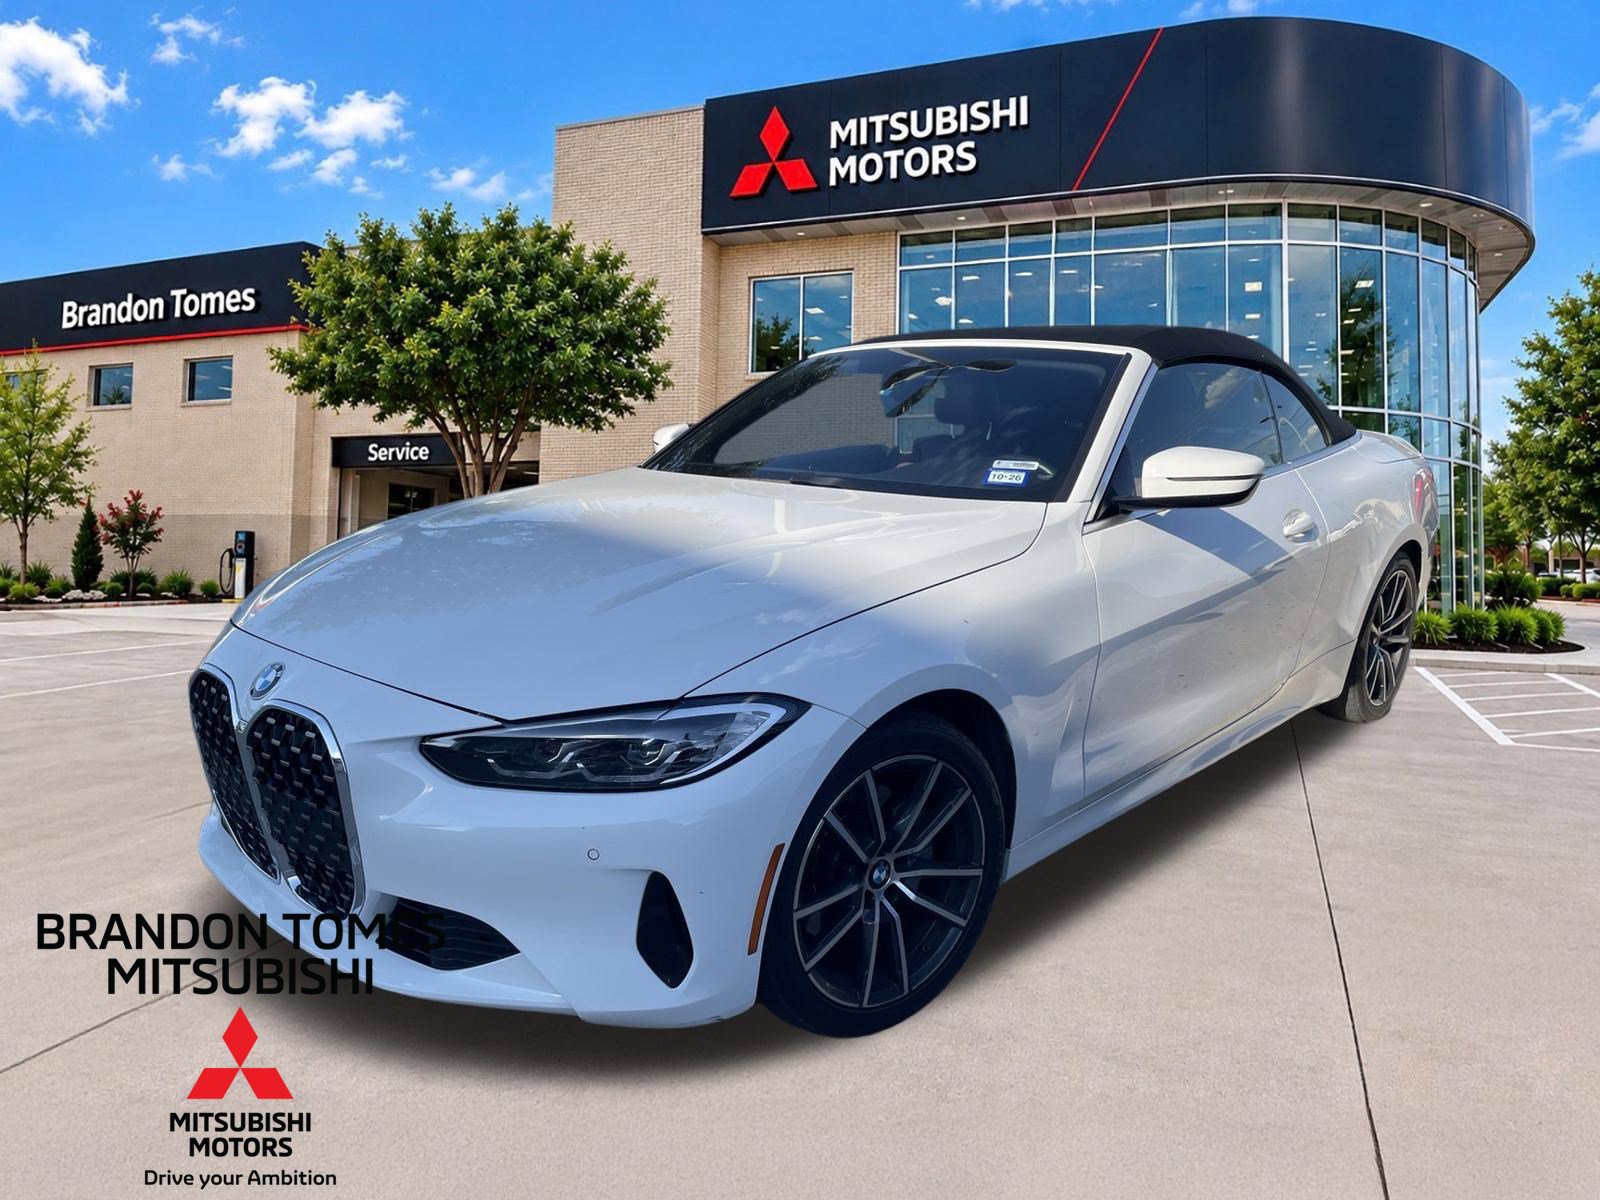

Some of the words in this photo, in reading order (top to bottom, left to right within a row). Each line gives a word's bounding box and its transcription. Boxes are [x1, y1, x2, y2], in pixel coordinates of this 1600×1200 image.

[830, 95, 1028, 149] MITSUBISHI
[828, 141, 977, 187] MOTORS
[62, 293, 165, 329] Brandon
[171, 287, 256, 318] Tomes
[368, 442, 430, 462] Service
